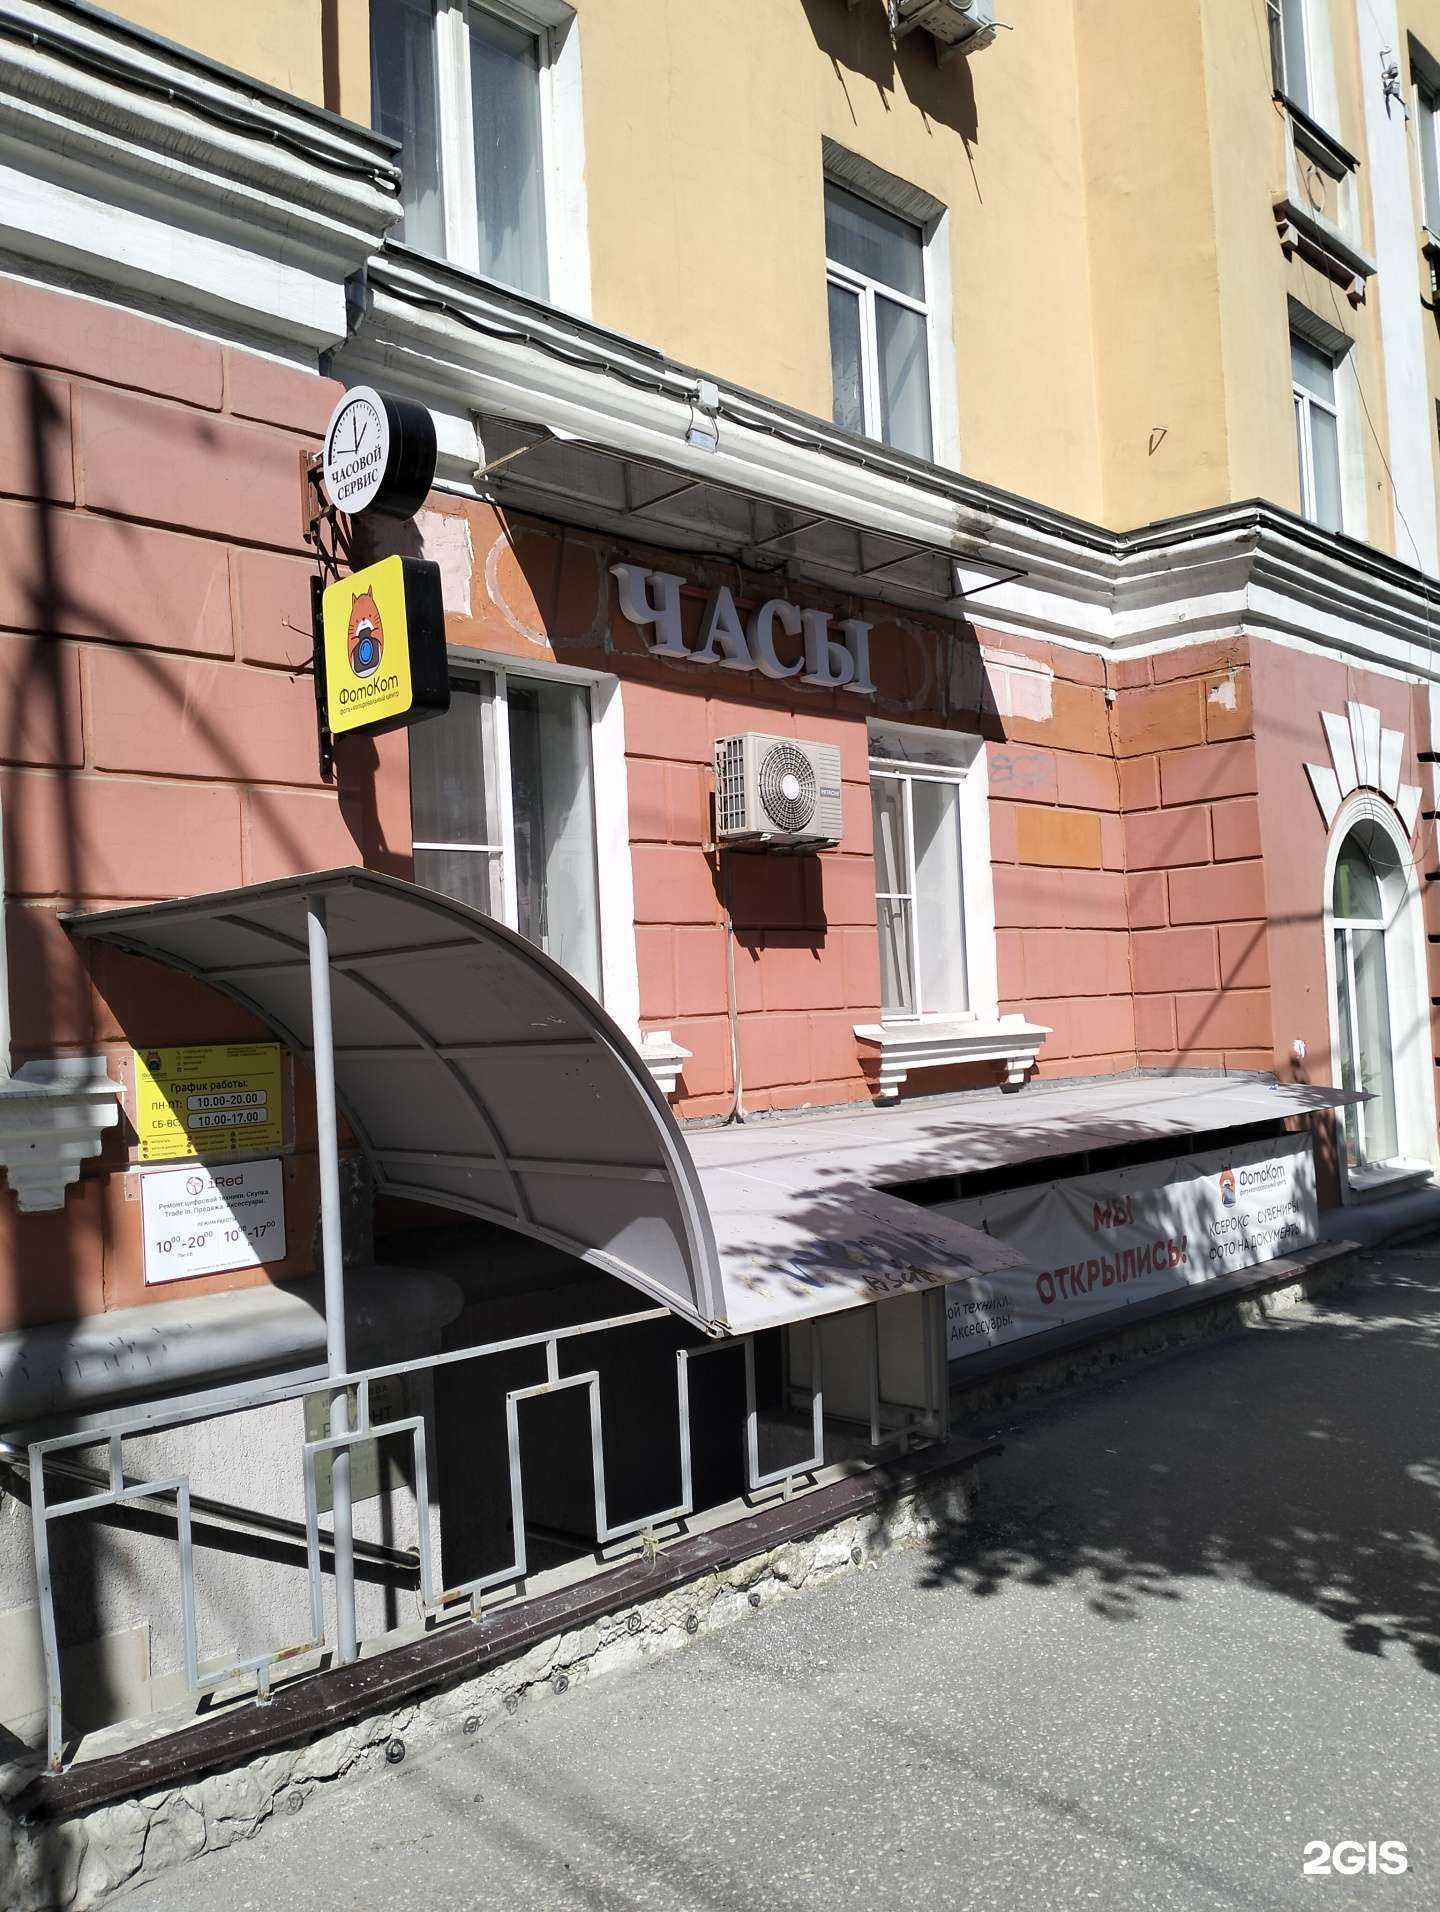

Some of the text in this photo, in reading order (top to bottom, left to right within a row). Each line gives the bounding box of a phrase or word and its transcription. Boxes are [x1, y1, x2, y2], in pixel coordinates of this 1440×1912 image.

[331, 444, 382, 484] ЧАСОВОЙ
[337, 468, 379, 501] СЕРВИС
[610, 562, 878, 694] ЧАСЫ
[151, 1093, 258, 1111] ПН-ПТ: 10.00-20.00
[170, 1080, 248, 1094] График работы:
[152, 1111, 259, 1129] СБ-ВС: 10.00-17.00
[208, 1174, 244, 1189] iRed
[1092, 1194, 1135, 1233] МЫ
[1209, 1200, 1299, 1237] КСЕРОКС СУВЕНИРЫ
[1209, 1223, 1301, 1260] ФОТО НА ДОКУМЕНТЫ
[1036, 1234, 1188, 1305] ОТКРЫЛИСЬ!
[946, 1303, 960, 1320] ой
